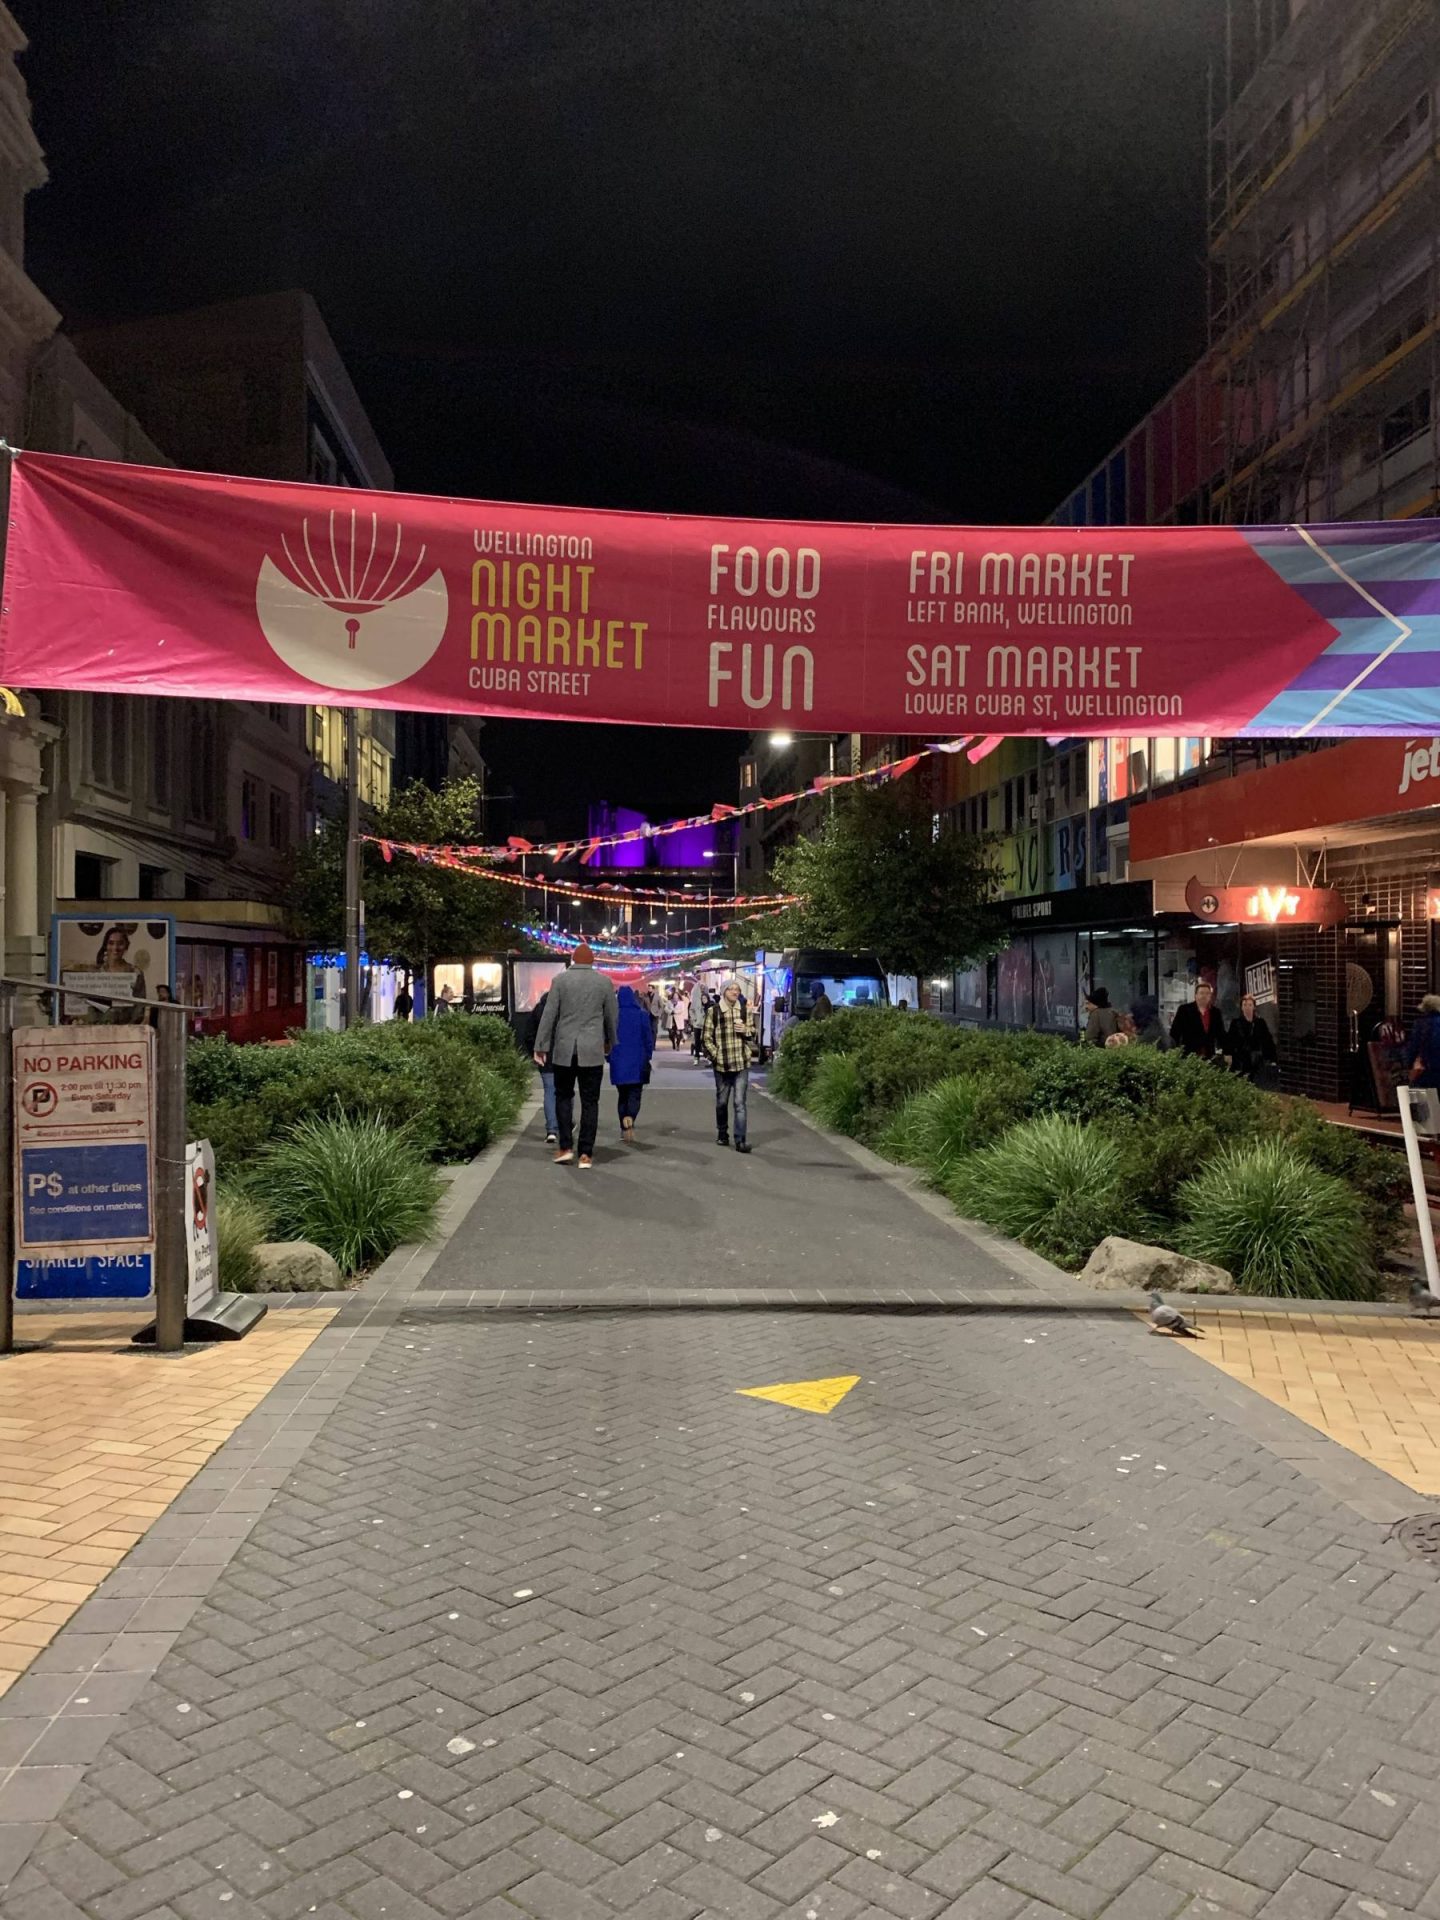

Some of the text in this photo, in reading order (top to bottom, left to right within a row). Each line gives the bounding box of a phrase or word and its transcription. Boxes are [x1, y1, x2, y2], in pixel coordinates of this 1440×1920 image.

[474, 529, 593, 560] WELLINGTON
[471, 559, 595, 614] NIGHT
[710, 544, 821, 599] FOOD
[909, 550, 1135, 597] FRI MARKET
[707, 604, 816, 633] FLAVOURS
[907, 600, 1133, 630] LEFT BANK, WELLINGTON
[470, 611, 649, 669] MARKET
[469, 667, 592, 696] CUBA STREET
[708, 641, 814, 711] FUN
[906, 644, 1142, 689] SAT MARKET
[905, 693, 1183, 720] LOWER CUBA ST, WELLINGTON
[1033, 900, 1052, 917] SPORT
[1247, 886, 1300, 923] IVY
[1247, 964, 1272, 995] REBEL
[471, 1003, 505, 1013] Indonesia
[23, 1053, 142, 1073] NO PARKING
[72, 1091, 131, 1102] Every Saturday
[28, 1171, 142, 1199] P$ at other times
[29, 1201, 144, 1215] See conditions on machine.
